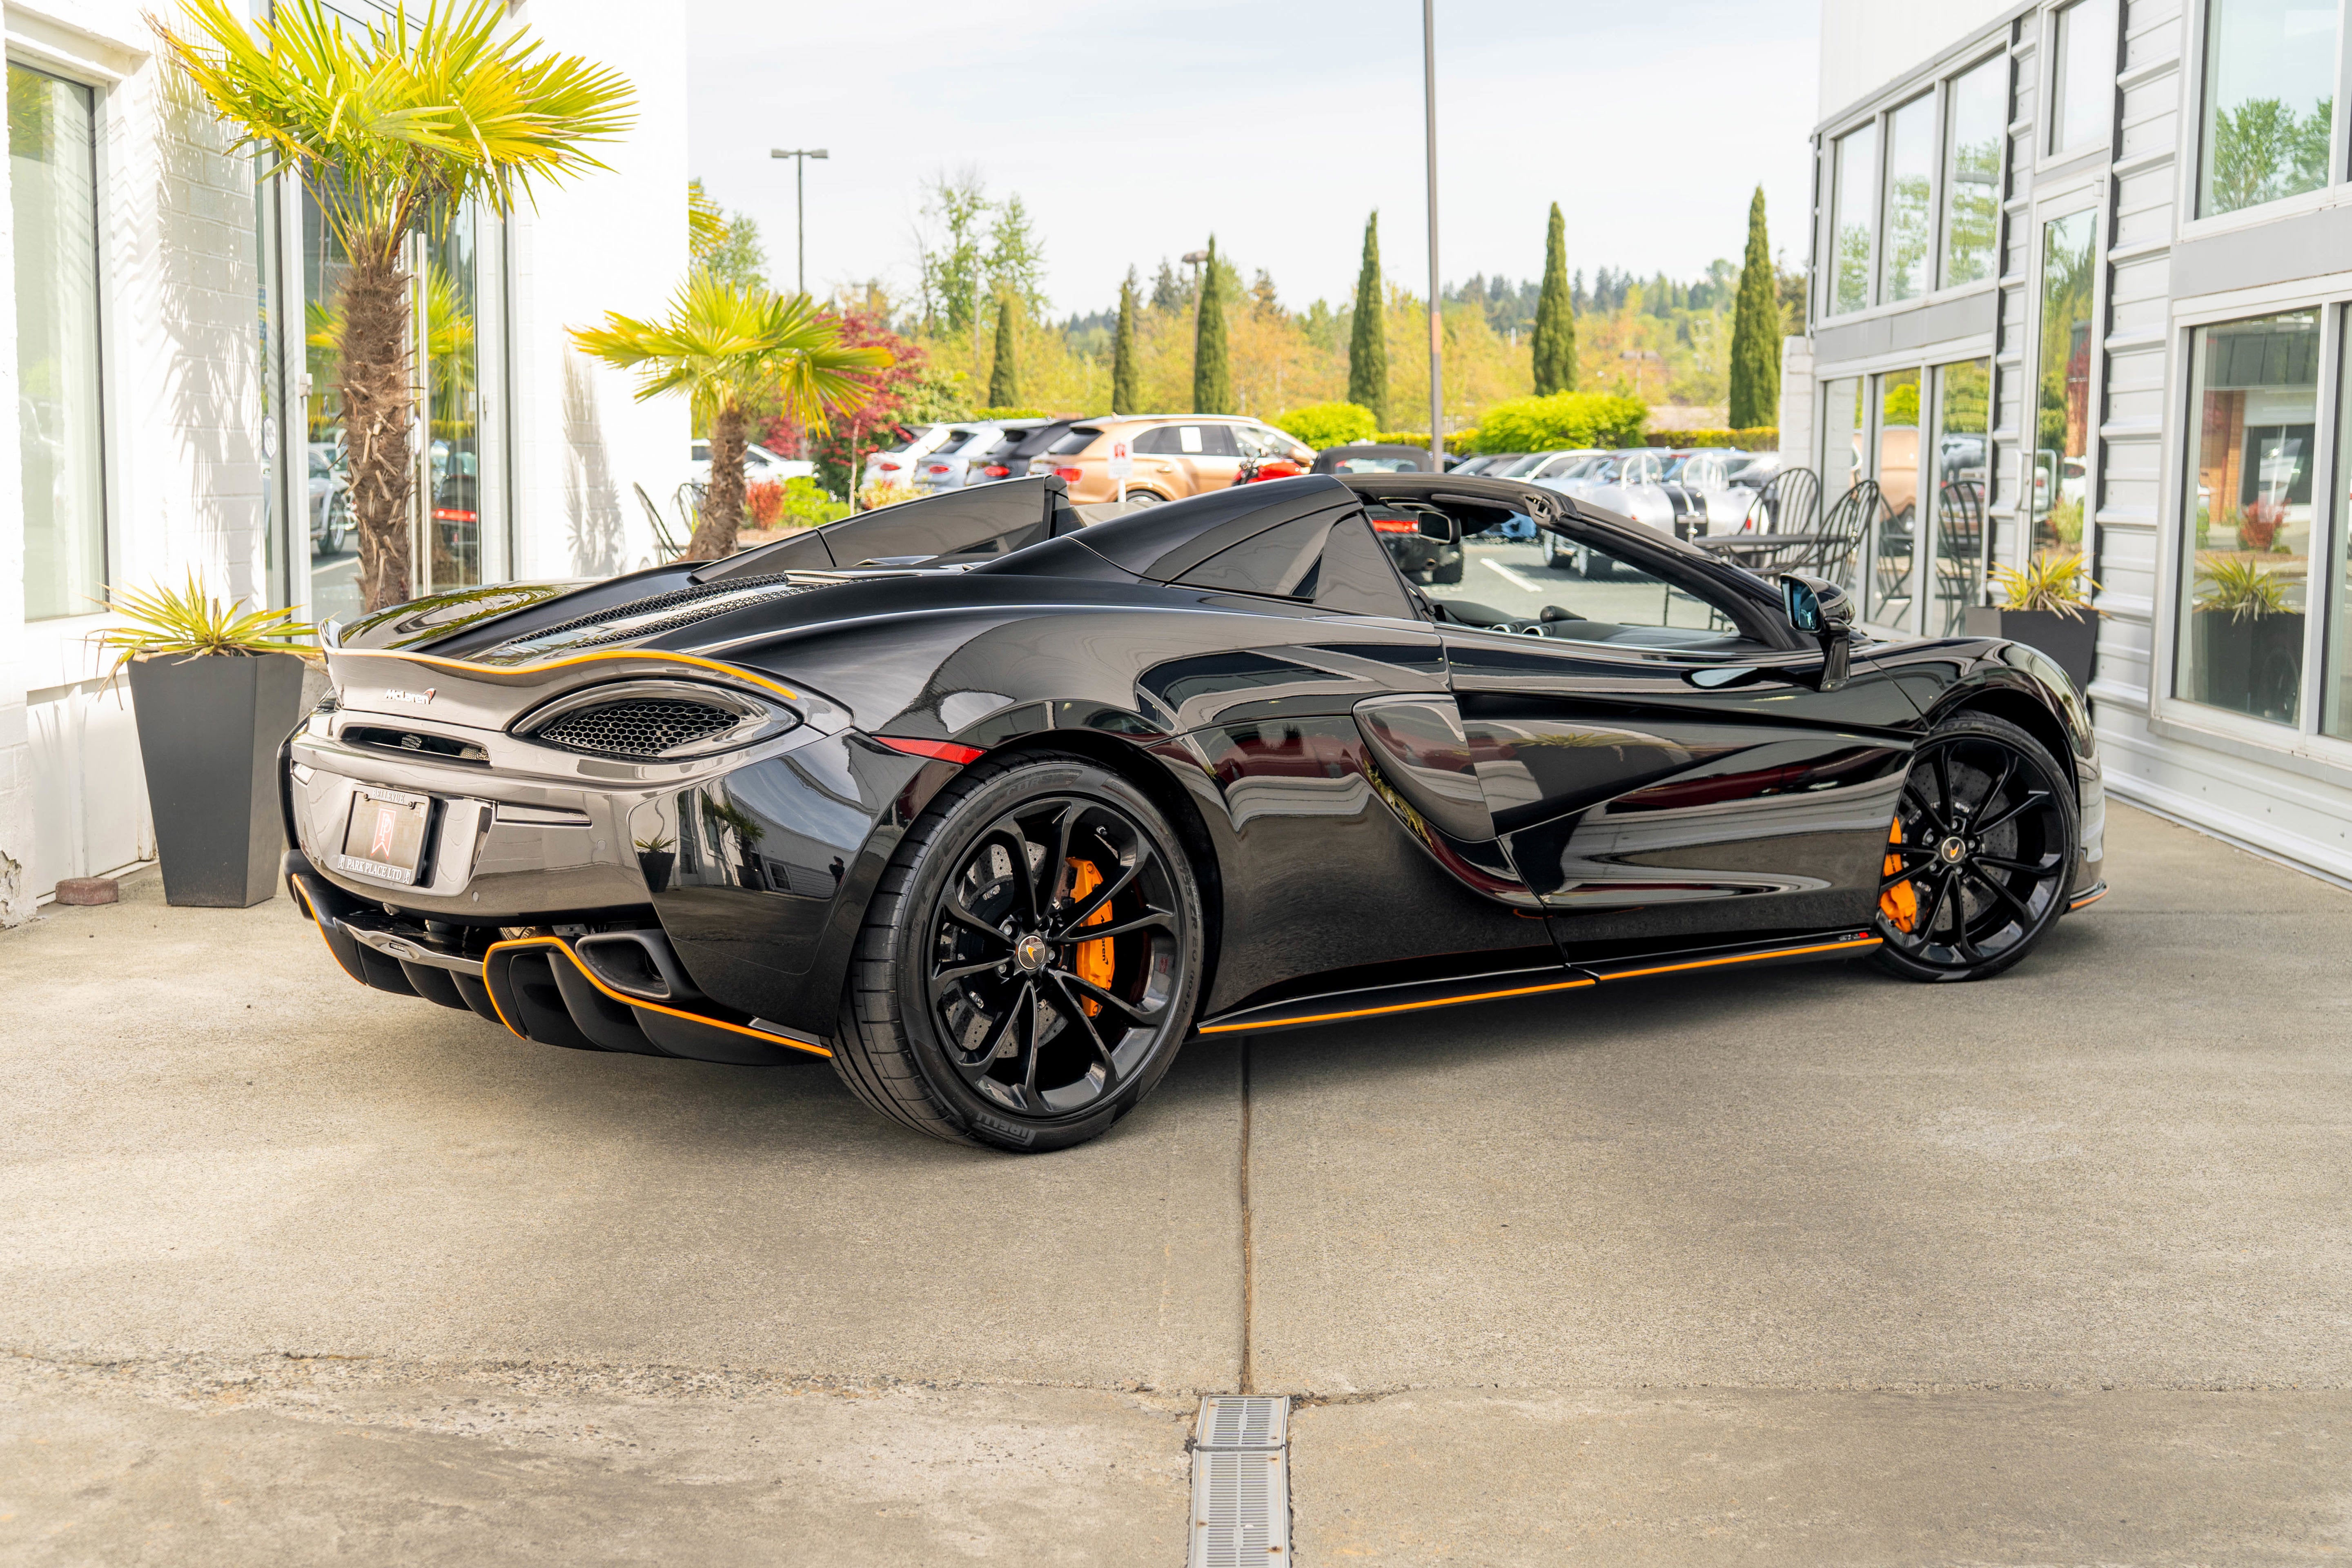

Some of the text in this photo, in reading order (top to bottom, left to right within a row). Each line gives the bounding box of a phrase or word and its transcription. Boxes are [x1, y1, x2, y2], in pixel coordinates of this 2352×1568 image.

[385, 689, 430, 705] McLaren
[372, 788, 405, 804] BELLEVUE
[346, 858, 365, 872] PARK
[364, 862, 388, 878] PLACE
[386, 868, 402, 881] LTD
[972, 1110, 1036, 1146] PIRELLI
